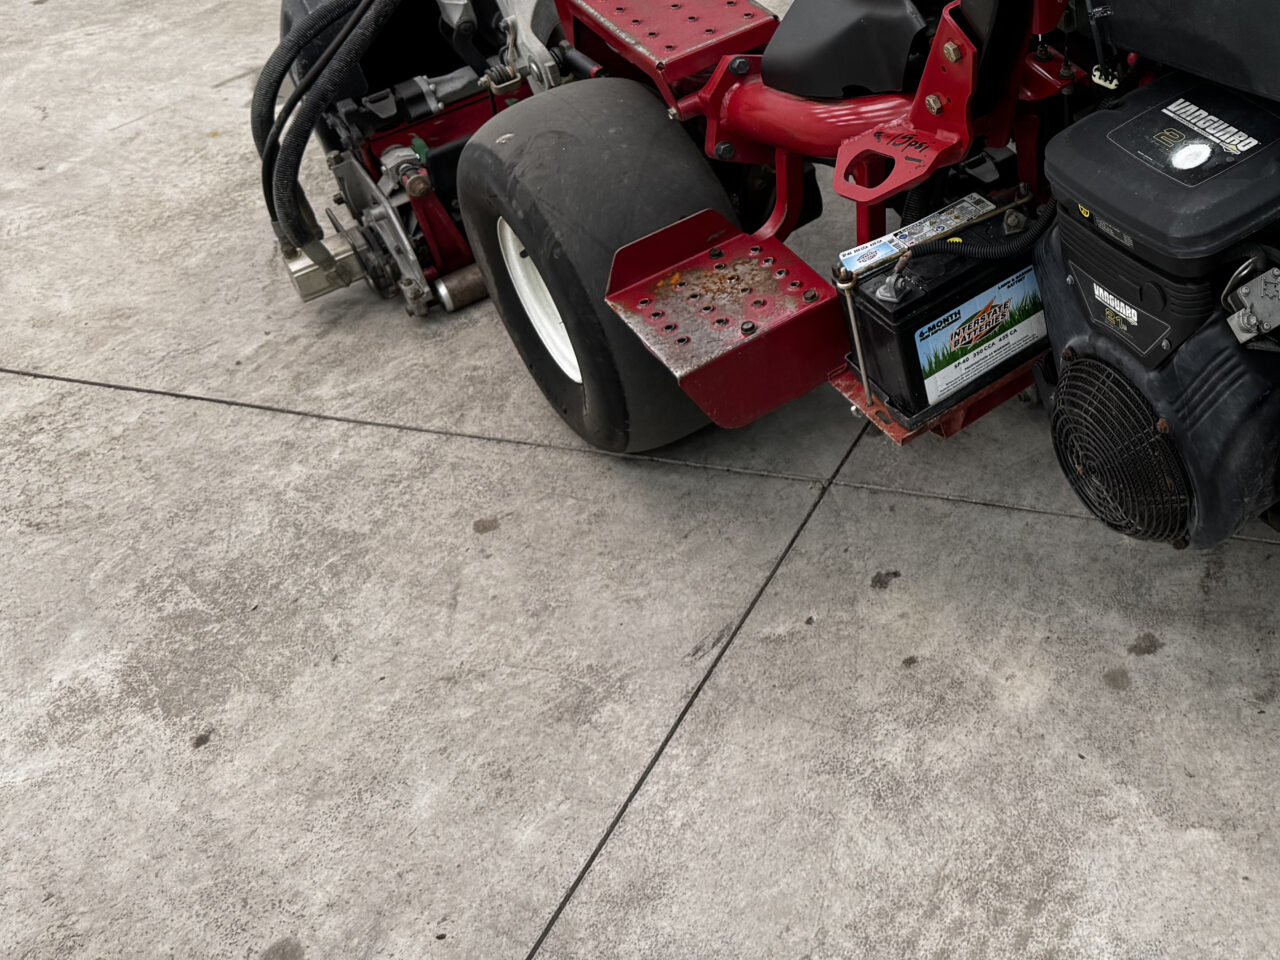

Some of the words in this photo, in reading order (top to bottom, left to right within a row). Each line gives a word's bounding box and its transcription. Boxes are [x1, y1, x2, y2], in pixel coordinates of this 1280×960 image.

[1165, 98, 1259, 152] VANGUARD
[950, 300, 1010, 341] INTERSTATE
[1093, 282, 1138, 322] VANGUARD
[919, 309, 961, 339] 6-MONTH
[953, 311, 1007, 348] BATTERIES
